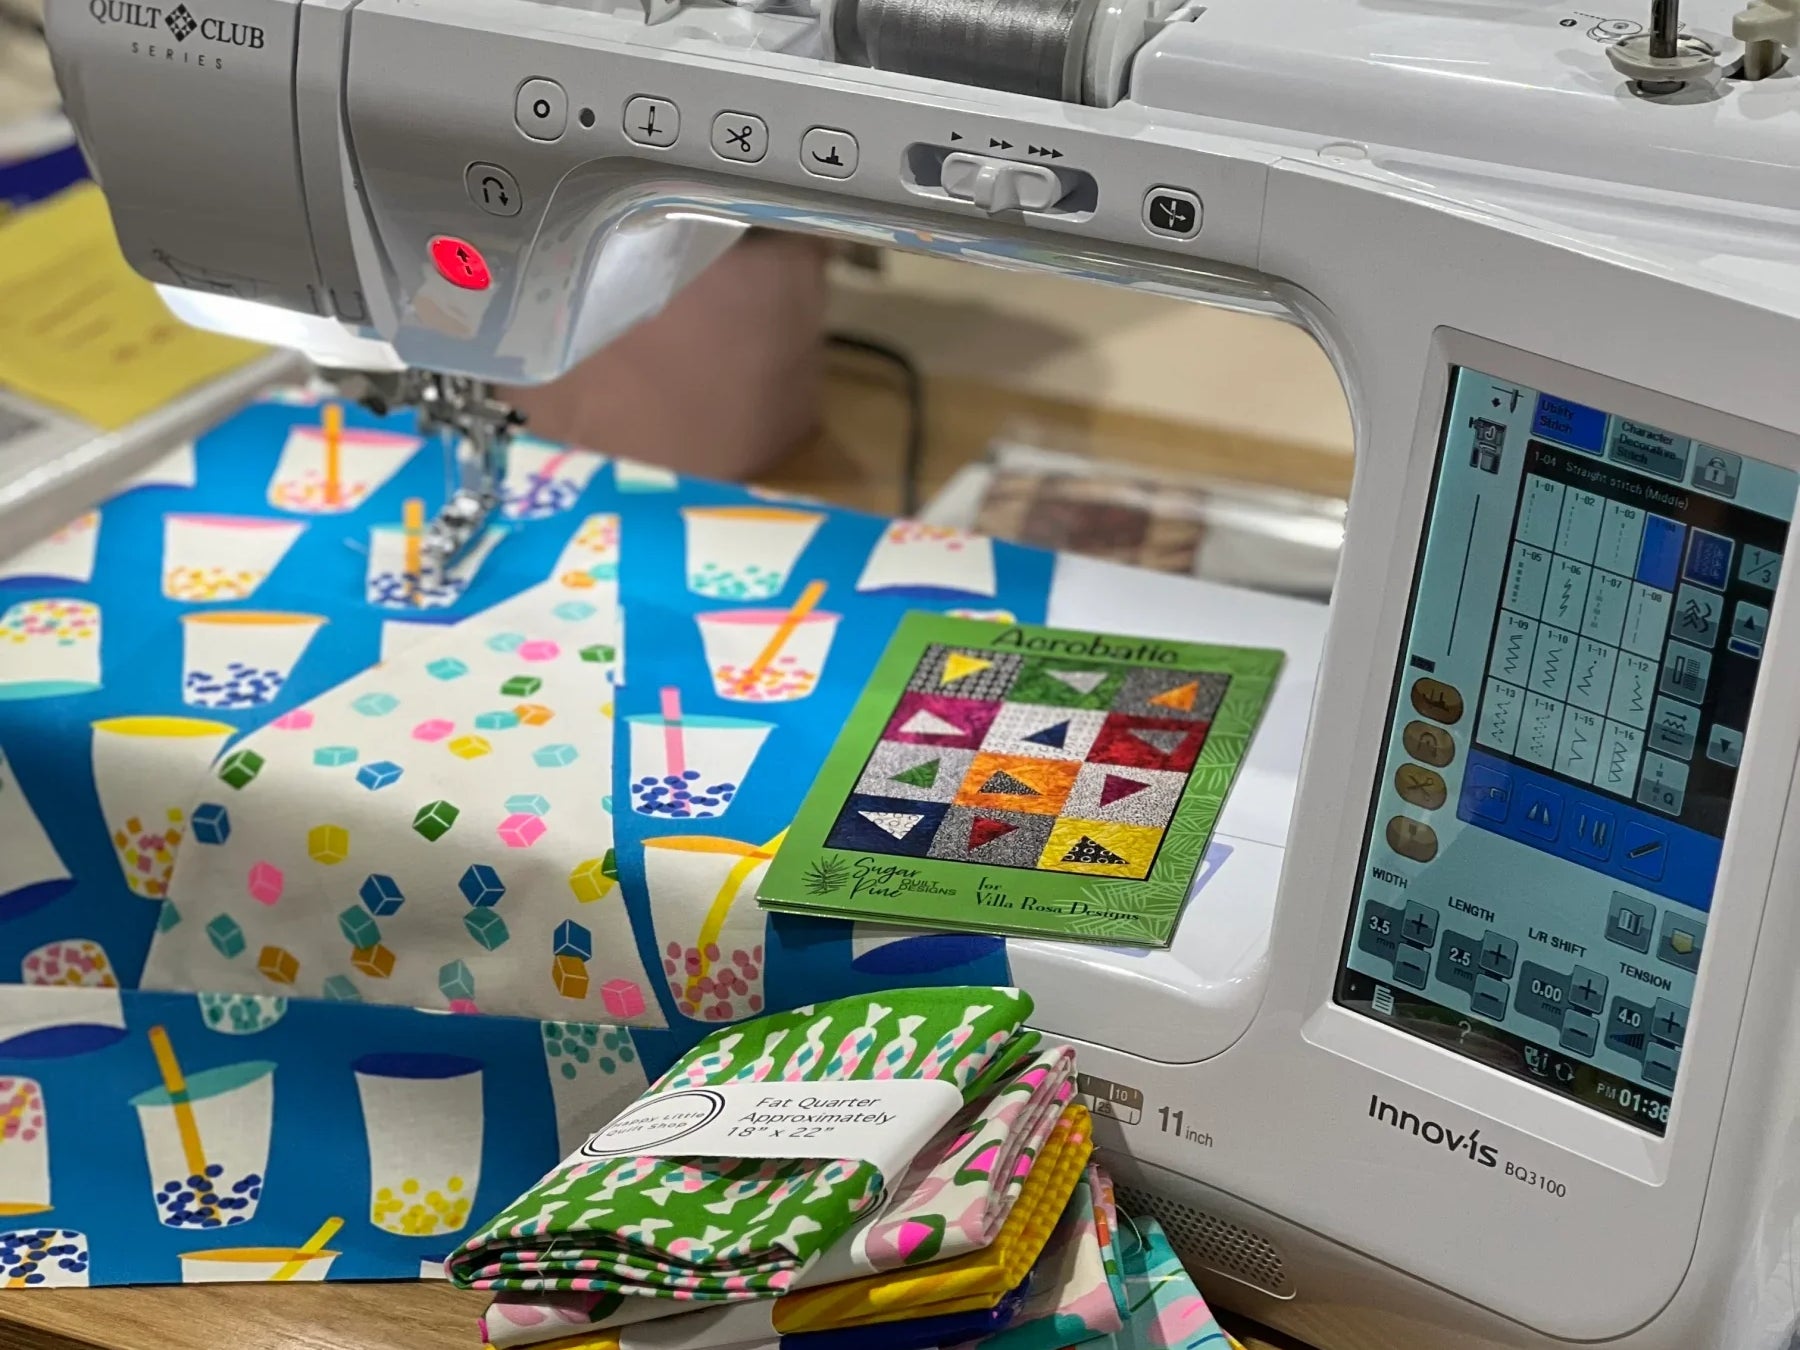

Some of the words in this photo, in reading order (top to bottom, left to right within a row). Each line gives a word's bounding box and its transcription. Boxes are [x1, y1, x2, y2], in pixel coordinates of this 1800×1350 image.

[89, 0, 161, 29] QUILT
[200, 18, 264, 49] CLUB
[131, 42, 223, 70] SERIES
[1541, 400, 1575, 420] Utility
[1621, 421, 1674, 446] Character
[1617, 448, 1648, 465] Stitch
[1619, 433, 1677, 460] Decorative
[1534, 451, 1557, 467] 1-04
[1566, 461, 1607, 483] Straight
[1645, 487, 1689, 510] (Middle)
[1535, 480, 1554, 493] 1-01
[1575, 493, 1595, 507] 1-02
[1614, 506, 1636, 520] 1-03
[1522, 548, 1542, 562] 1-05
[1561, 562, 1582, 575] 1-06
[1601, 575, 1622, 589] 1-07
[1642, 589, 1662, 602] 1-08
[991, 627, 1179, 664] Acrobatic
[1508, 616, 1529, 630] 1-09
[1548, 630, 1568, 644] 1-10
[1588, 644, 1607, 658] 1-11
[1627, 658, 1649, 672] 1-12
[1495, 684, 1516, 698] 1-13
[1535, 698, 1554, 712] 1-14
[1574, 712, 1594, 726] 1-15
[1614, 726, 1634, 741] 1-16
[852, 857, 922, 884] Sugar
[978, 876, 1002, 890] for
[1371, 867, 1408, 889] WIDTH
[850, 877, 903, 899] Pine
[898, 885, 957, 896] DESIGNS
[901, 879, 940, 888] QUILT
[976, 891, 1013, 909] Villa
[1020, 896, 1063, 914] Rosa
[1070, 901, 1140, 921] Designs
[1448, 896, 1495, 923] LENGTH
[1369, 916, 1391, 935] 3.5
[1528, 927, 1549, 944] L/R
[1550, 934, 1587, 958] SHIFT
[1449, 948, 1471, 966] 2.5
[1619, 962, 1672, 991] TENSION
[1531, 979, 1562, 1002] 0.00
[1618, 1008, 1641, 1027] 4.0
[755, 1097, 793, 1108] Fat
[797, 1097, 882, 1110] Quarter
[1097, 1102, 1111, 1113] 25
[1116, 1089, 1128, 1101] 10
[1596, 1083, 1617, 1099] PM
[1619, 1088, 1669, 1123] 01:38
[663, 1111, 705, 1120] Little
[738, 1111, 897, 1125] Approximately
[1158, 1106, 1183, 1136] 11
[1185, 1126, 1213, 1148] inch
[606, 1125, 644, 1137] Quilt
[647, 1122, 688, 1130] Shop
[1504, 1161, 1567, 1198] BQ3100
